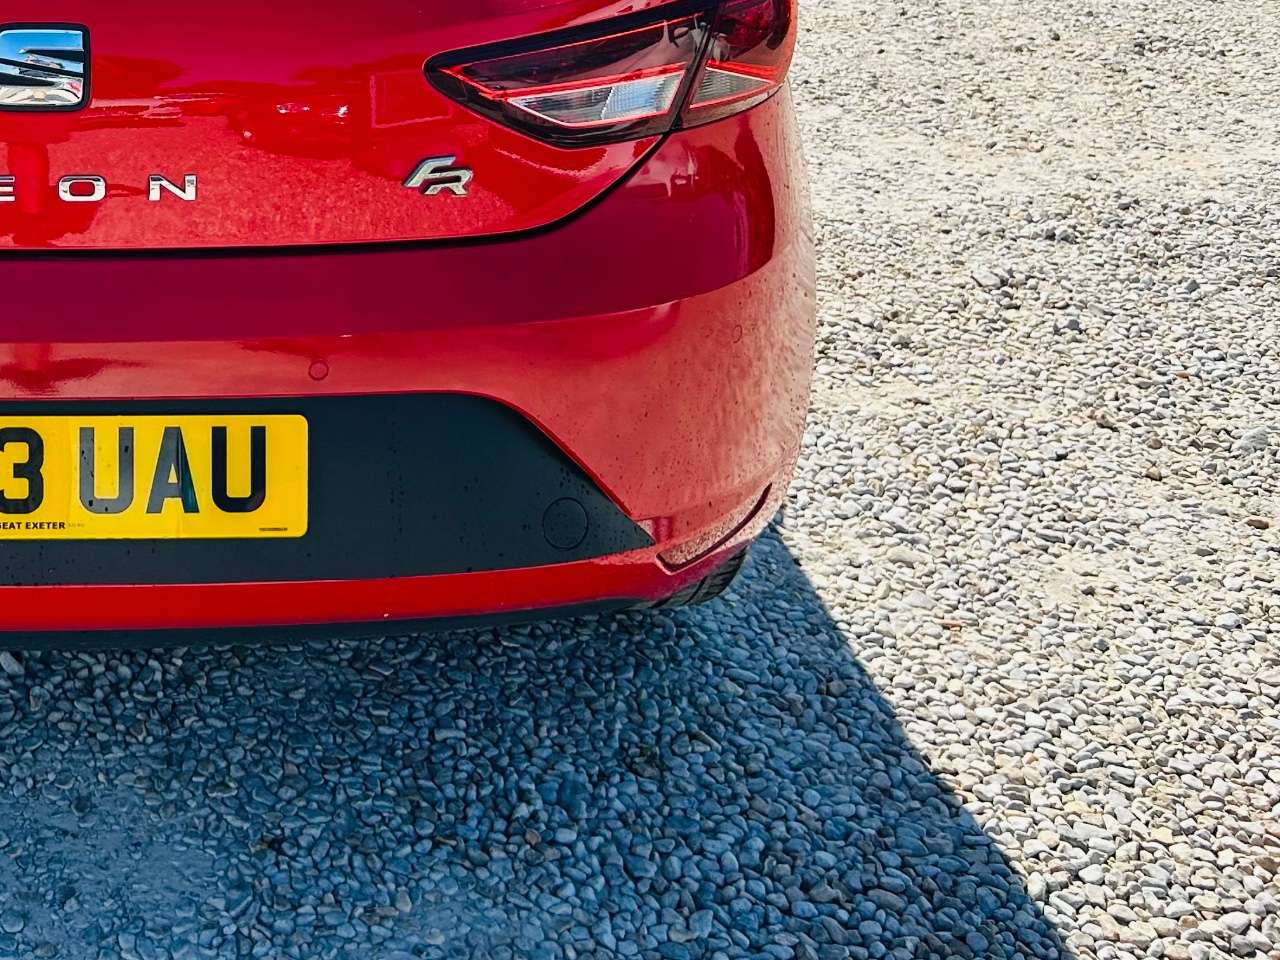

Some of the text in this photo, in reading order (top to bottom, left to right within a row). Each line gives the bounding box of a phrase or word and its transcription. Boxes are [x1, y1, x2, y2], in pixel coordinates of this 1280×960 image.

[403, 156, 473, 198] FR
[78, 426, 268, 514] UAU
[25, 521, 66, 530] EXETER
